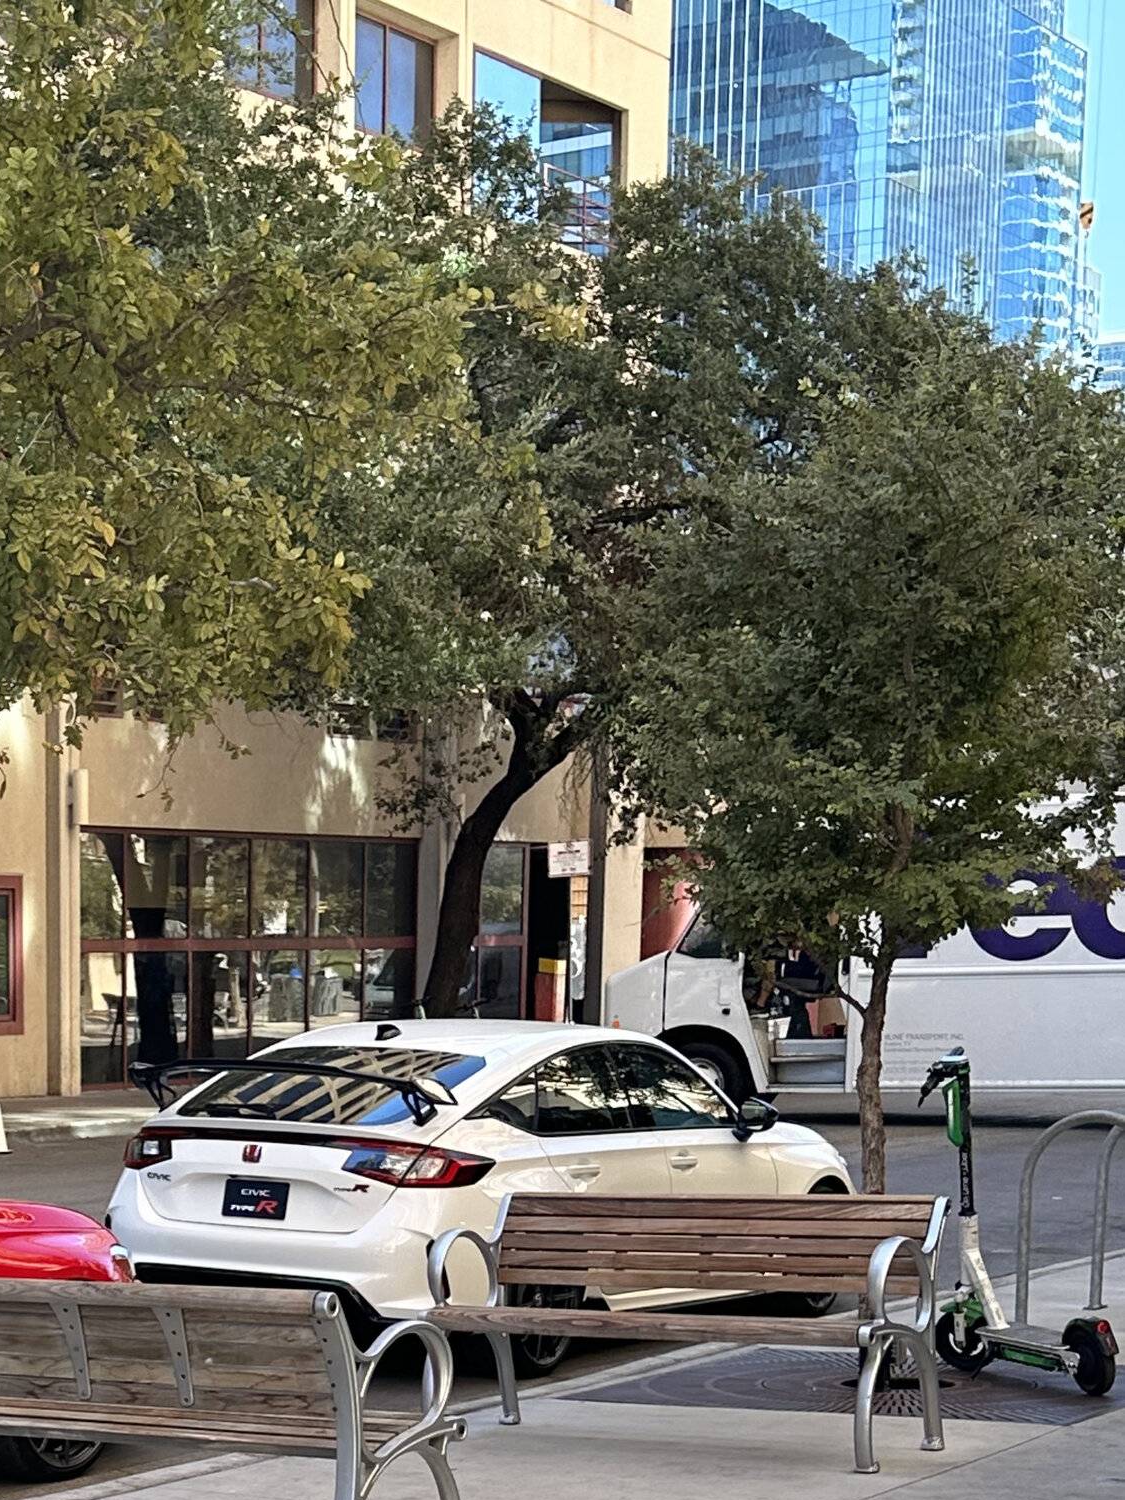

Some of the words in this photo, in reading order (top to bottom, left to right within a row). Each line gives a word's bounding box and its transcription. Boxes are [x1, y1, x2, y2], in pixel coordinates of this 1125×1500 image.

[146, 1171, 172, 1182] CIVIC
[240, 1188, 272, 1197] CIVIC
[230, 1204, 255, 1212] TYPE
[255, 1200, 279, 1214] R
